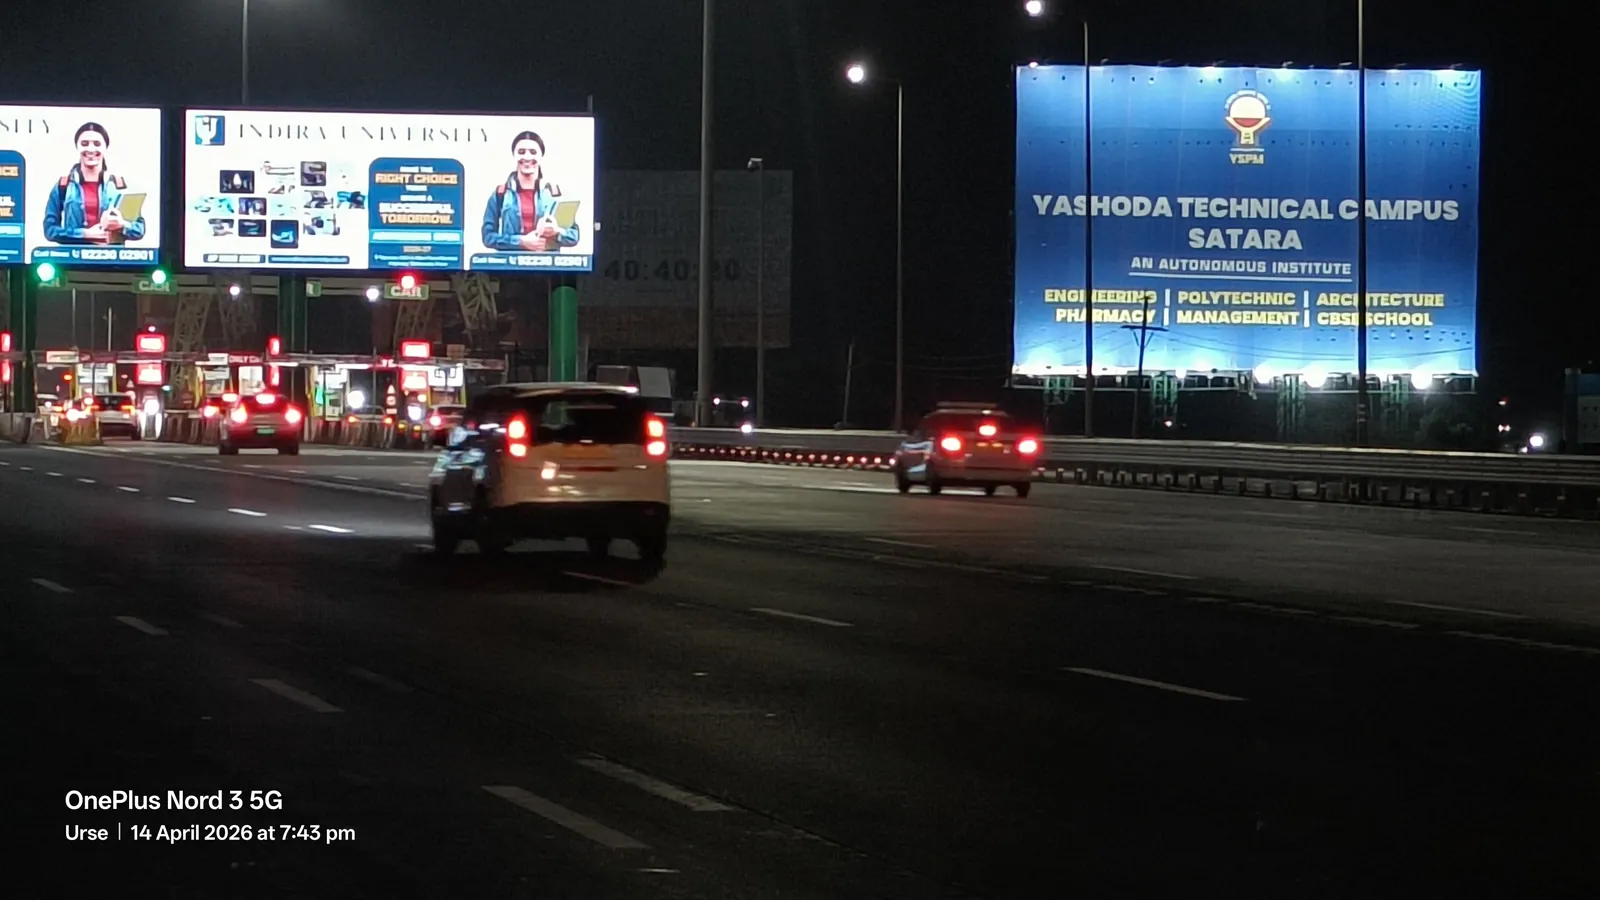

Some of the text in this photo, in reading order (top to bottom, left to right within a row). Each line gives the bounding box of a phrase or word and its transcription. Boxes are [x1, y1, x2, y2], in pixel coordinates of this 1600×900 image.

[239, 124, 488, 142] INDIRA UNIVERSITY
[1229, 153, 1265, 165] YSPM
[1033, 194, 1459, 221] YASHODA TECHNICAL CAMPUS
[1188, 227, 1303, 250] SATARA
[1131, 257, 1351, 275] AN AUTONOMOUS INSTITUTE
[1177, 290, 1296, 305] POLYTECHNIC
[1056, 308, 1157, 324] PHARMACY
[1176, 310, 1300, 325] MANAGEMENT
[1366, 312, 1434, 327] SCHOOL
